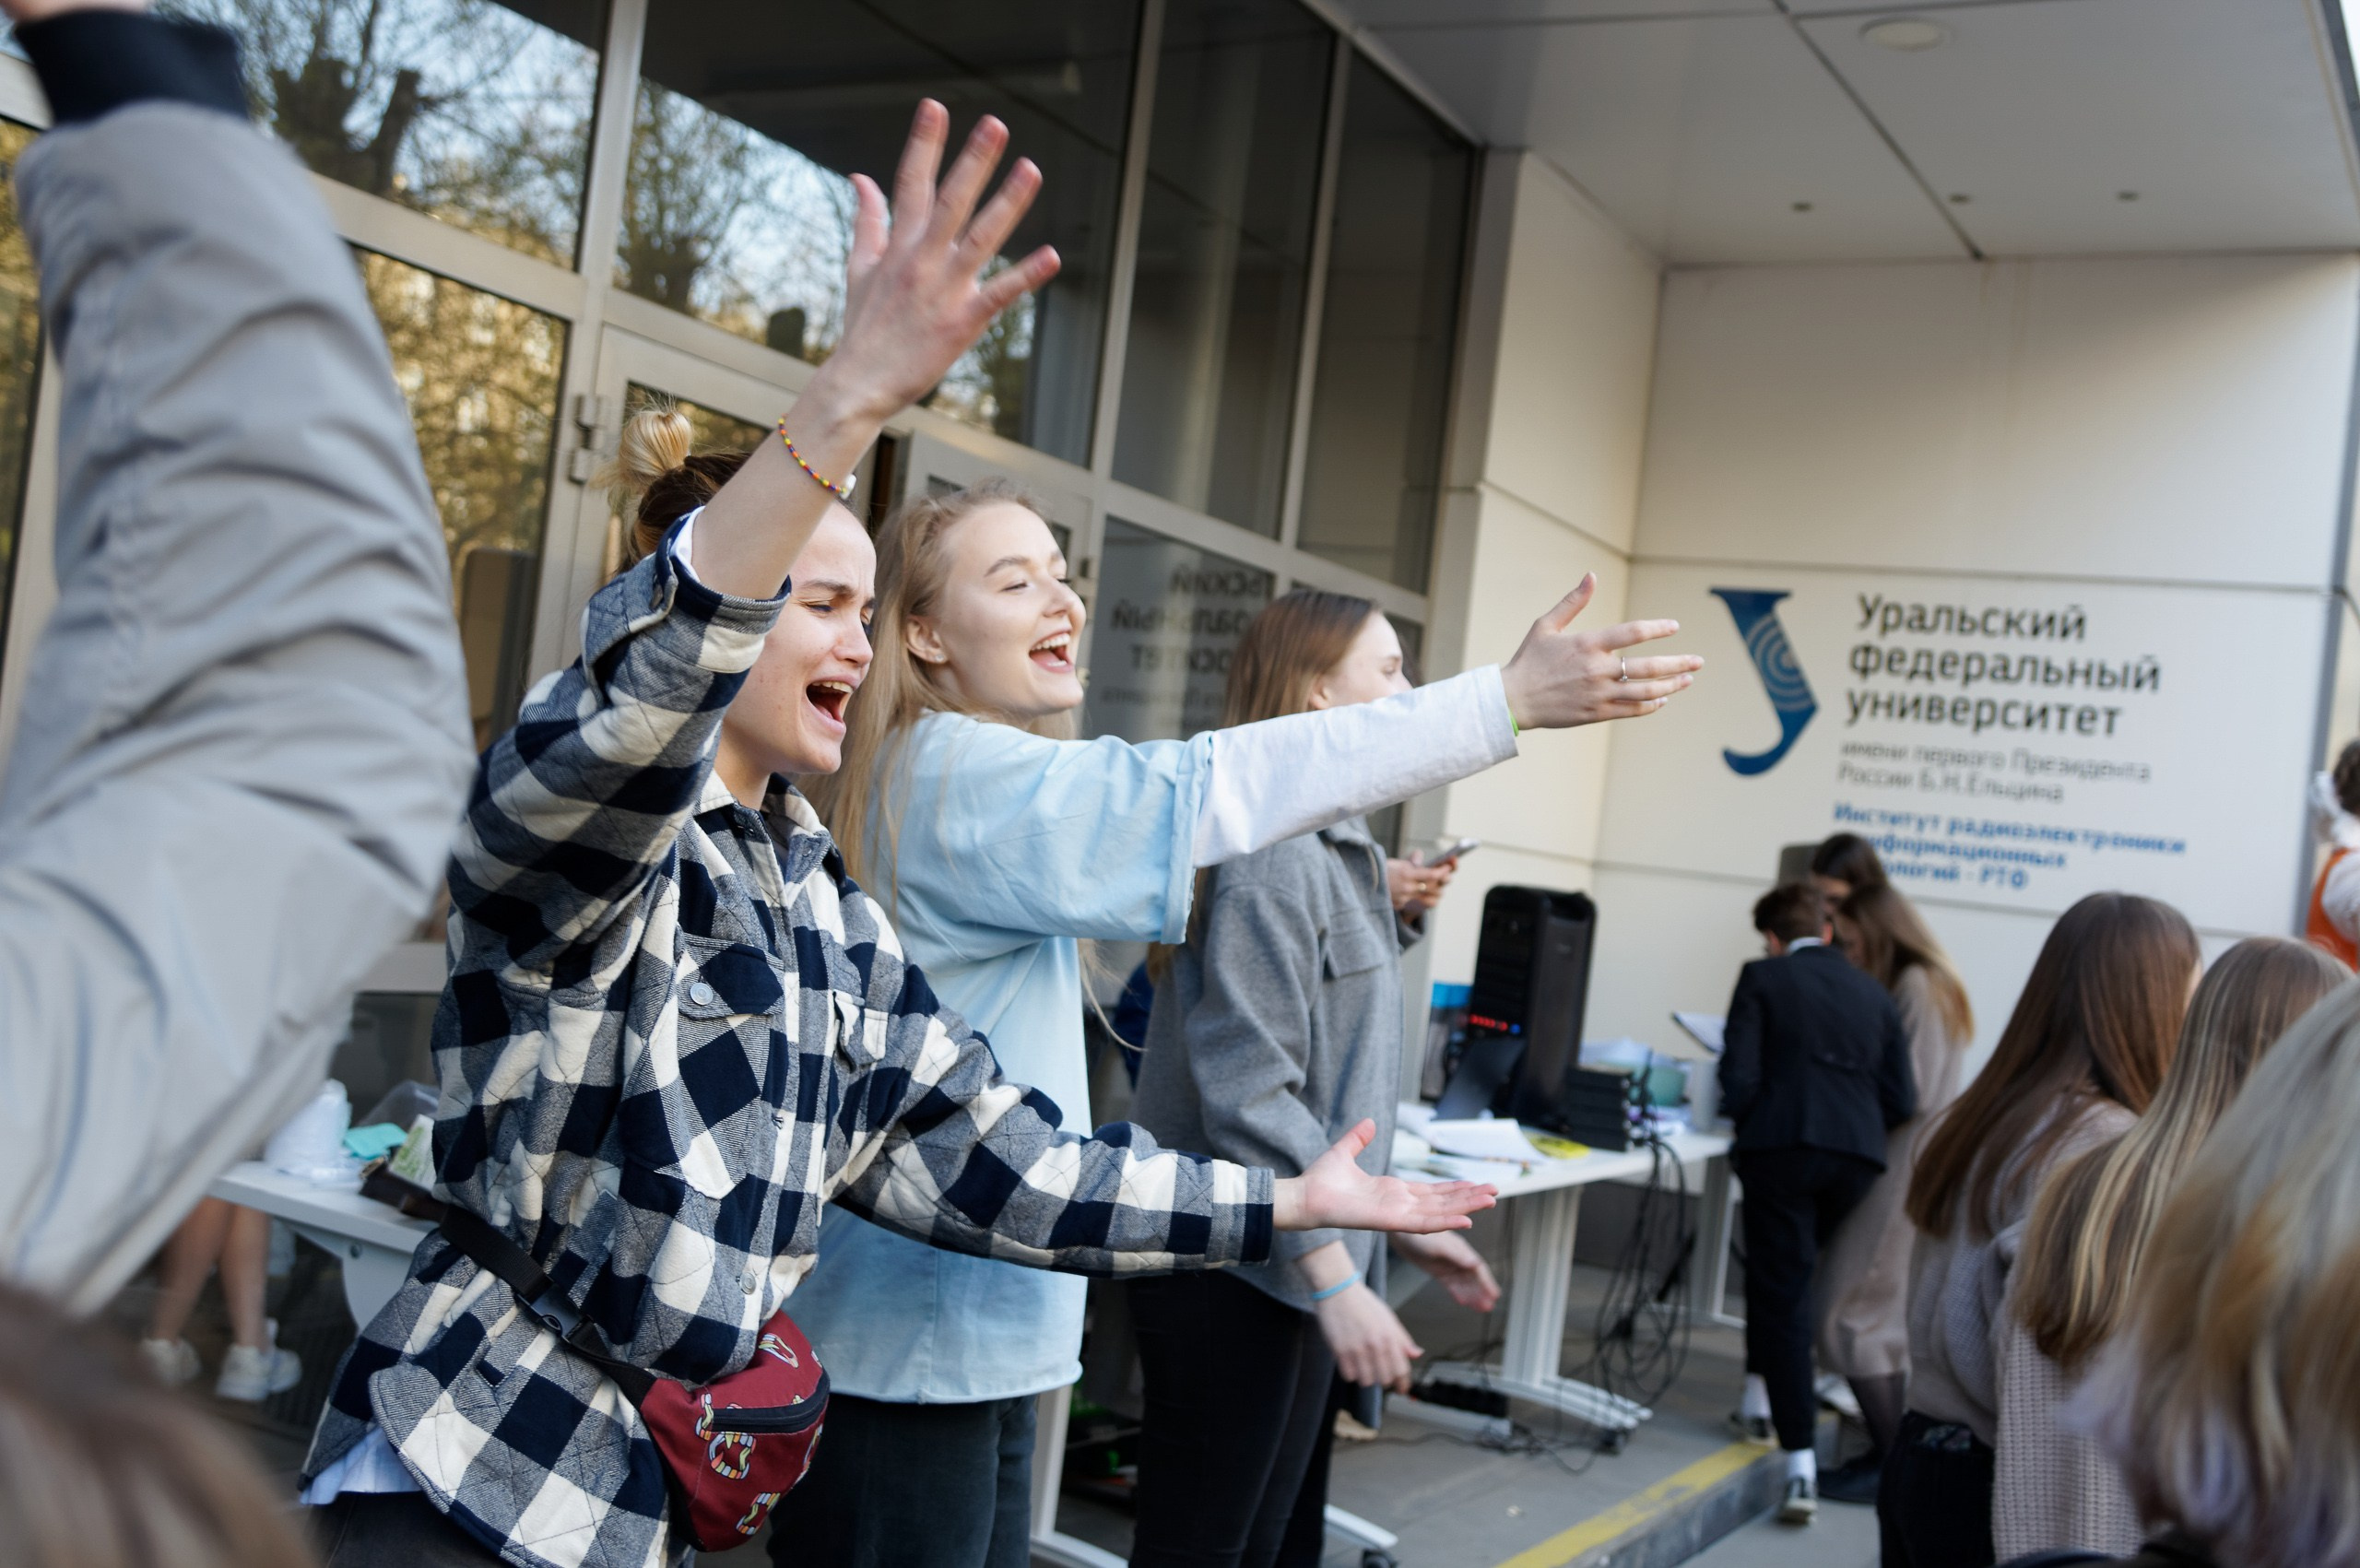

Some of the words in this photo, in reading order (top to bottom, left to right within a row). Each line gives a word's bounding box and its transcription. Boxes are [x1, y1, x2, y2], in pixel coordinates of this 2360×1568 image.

[1858, 593, 2086, 641] Уральский
[1849, 643, 2161, 691] федеральный
[1846, 690, 2122, 737] университет
[1838, 760, 1914, 787] России
[1841, 741, 1909, 760] имени
[1913, 745, 2007, 771] первого
[2012, 747, 2151, 783] Президента
[1835, 802, 1940, 831] Институт
[1948, 817, 2187, 853] радиоэлектроники
[1869, 833, 2066, 867] нформационных
